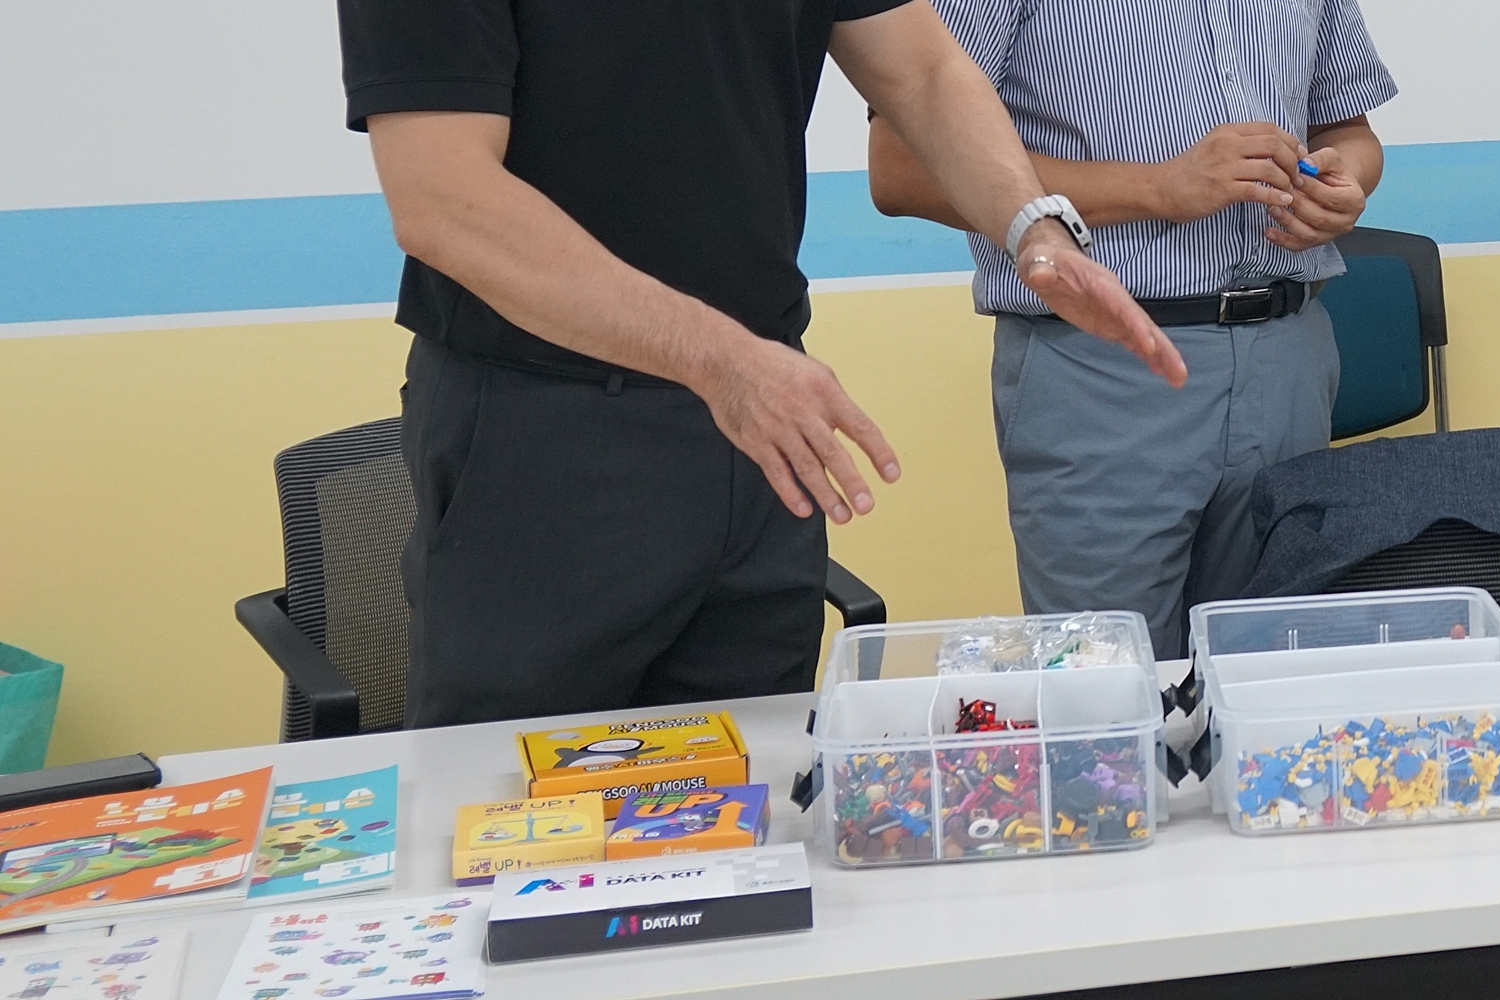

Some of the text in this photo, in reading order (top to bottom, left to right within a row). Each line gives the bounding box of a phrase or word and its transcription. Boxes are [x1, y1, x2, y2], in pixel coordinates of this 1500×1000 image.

[640, 782, 652, 794] AI
[661, 777, 707, 792] MOUSE
[530, 799, 563, 809] UP
[634, 793, 725, 818] UP
[494, 858, 514, 872] UP
[606, 875, 666, 886] DATA
[671, 869, 707, 879] KIT
[641, 916, 678, 931] DATA
[679, 912, 704, 927] KIT
